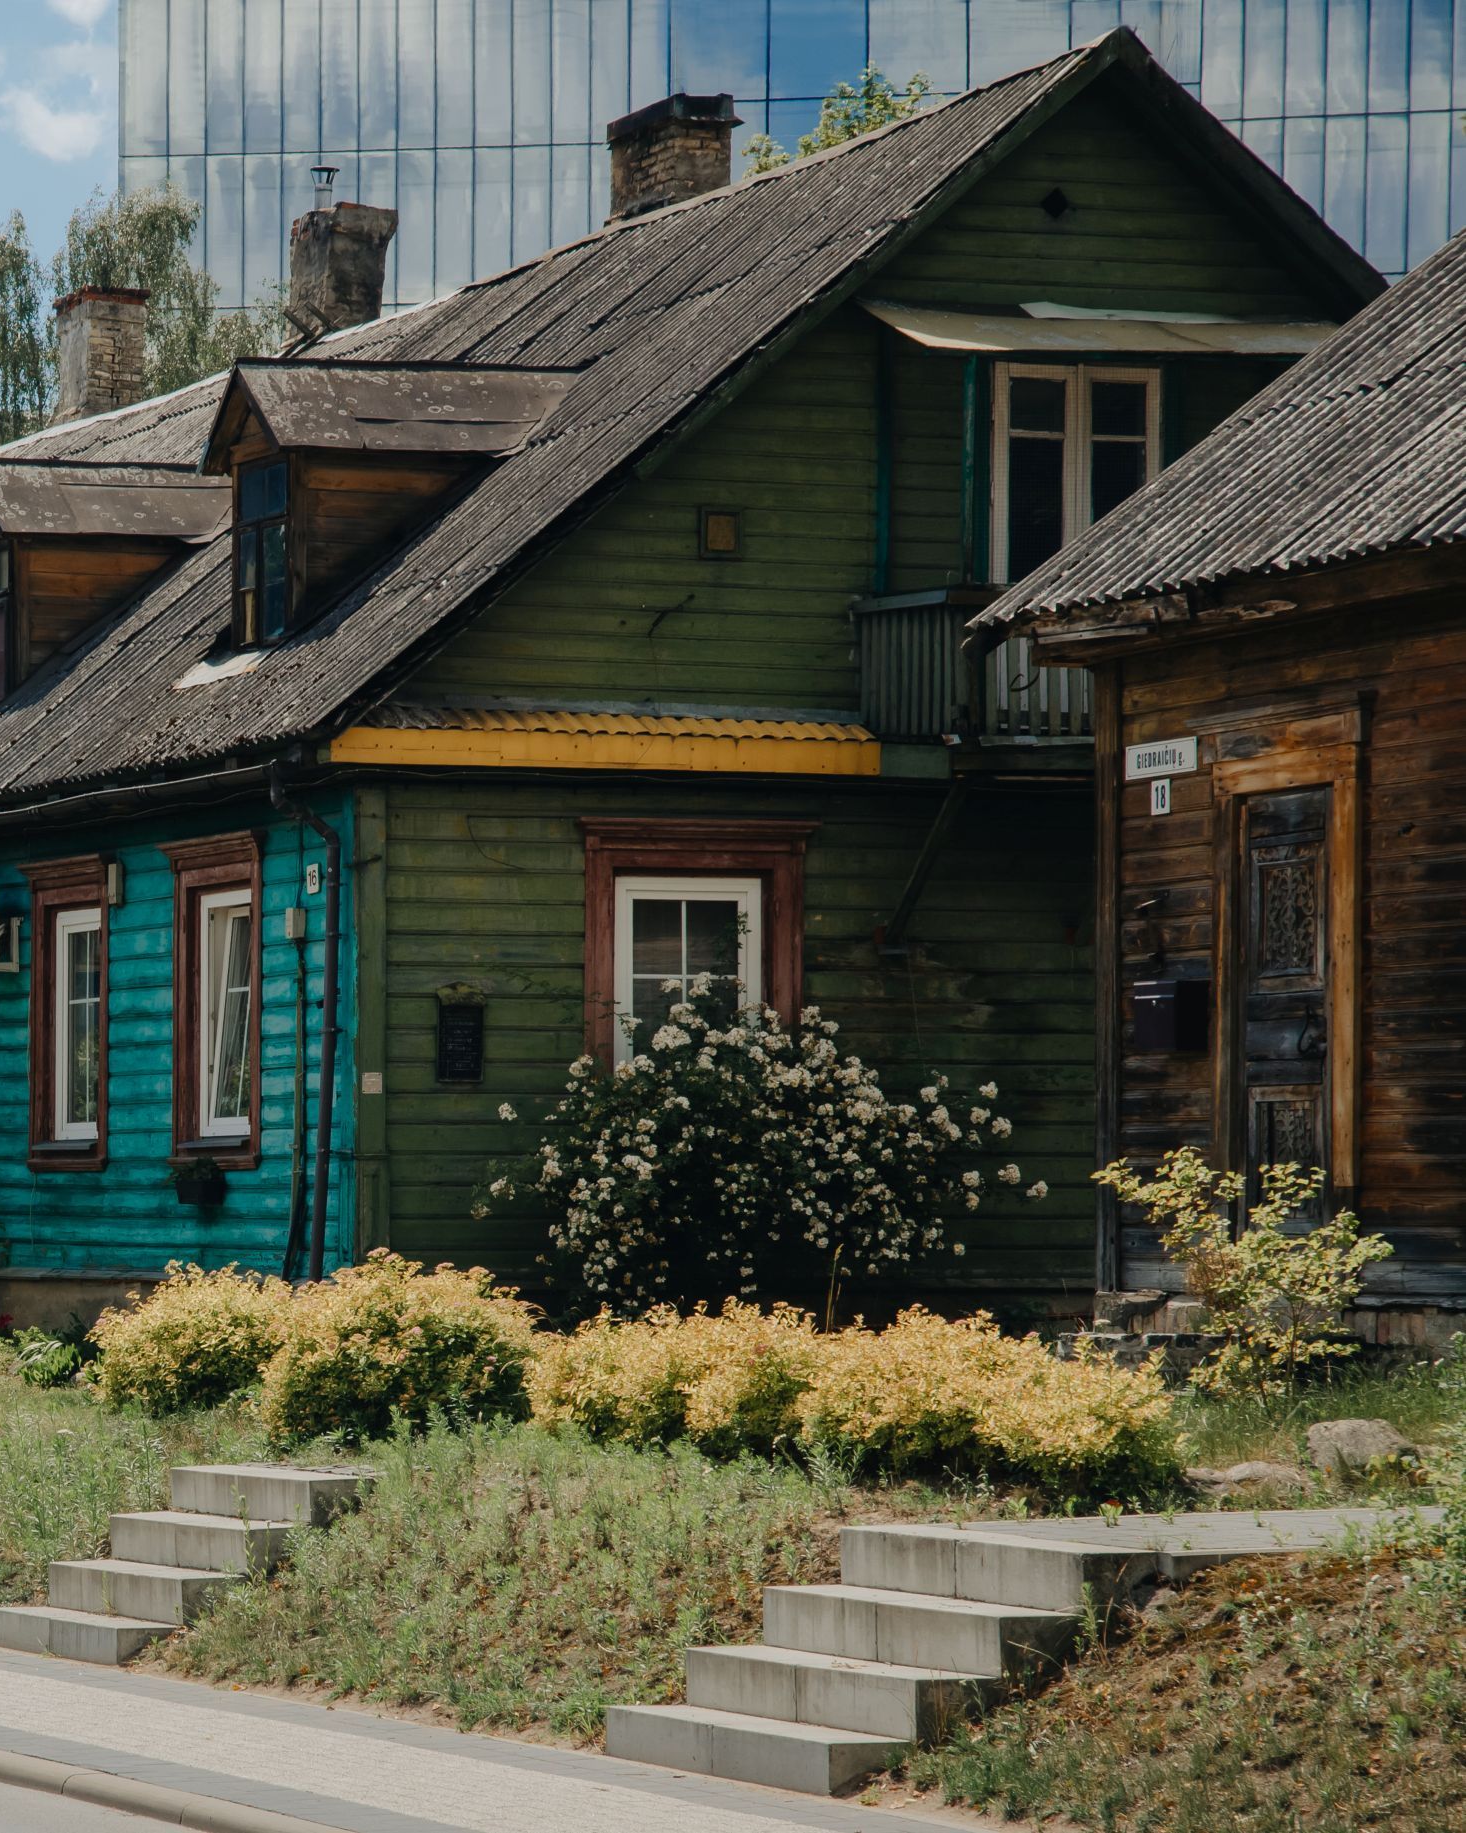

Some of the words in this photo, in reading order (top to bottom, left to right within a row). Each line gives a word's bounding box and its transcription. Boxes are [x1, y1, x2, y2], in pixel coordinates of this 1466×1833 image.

[1136, 745, 1176, 769] GIEDRAIČIŲ
[1178, 751, 1185, 767] g.
[1155, 785, 1166, 810] 18
[308, 869, 317, 887] 16
